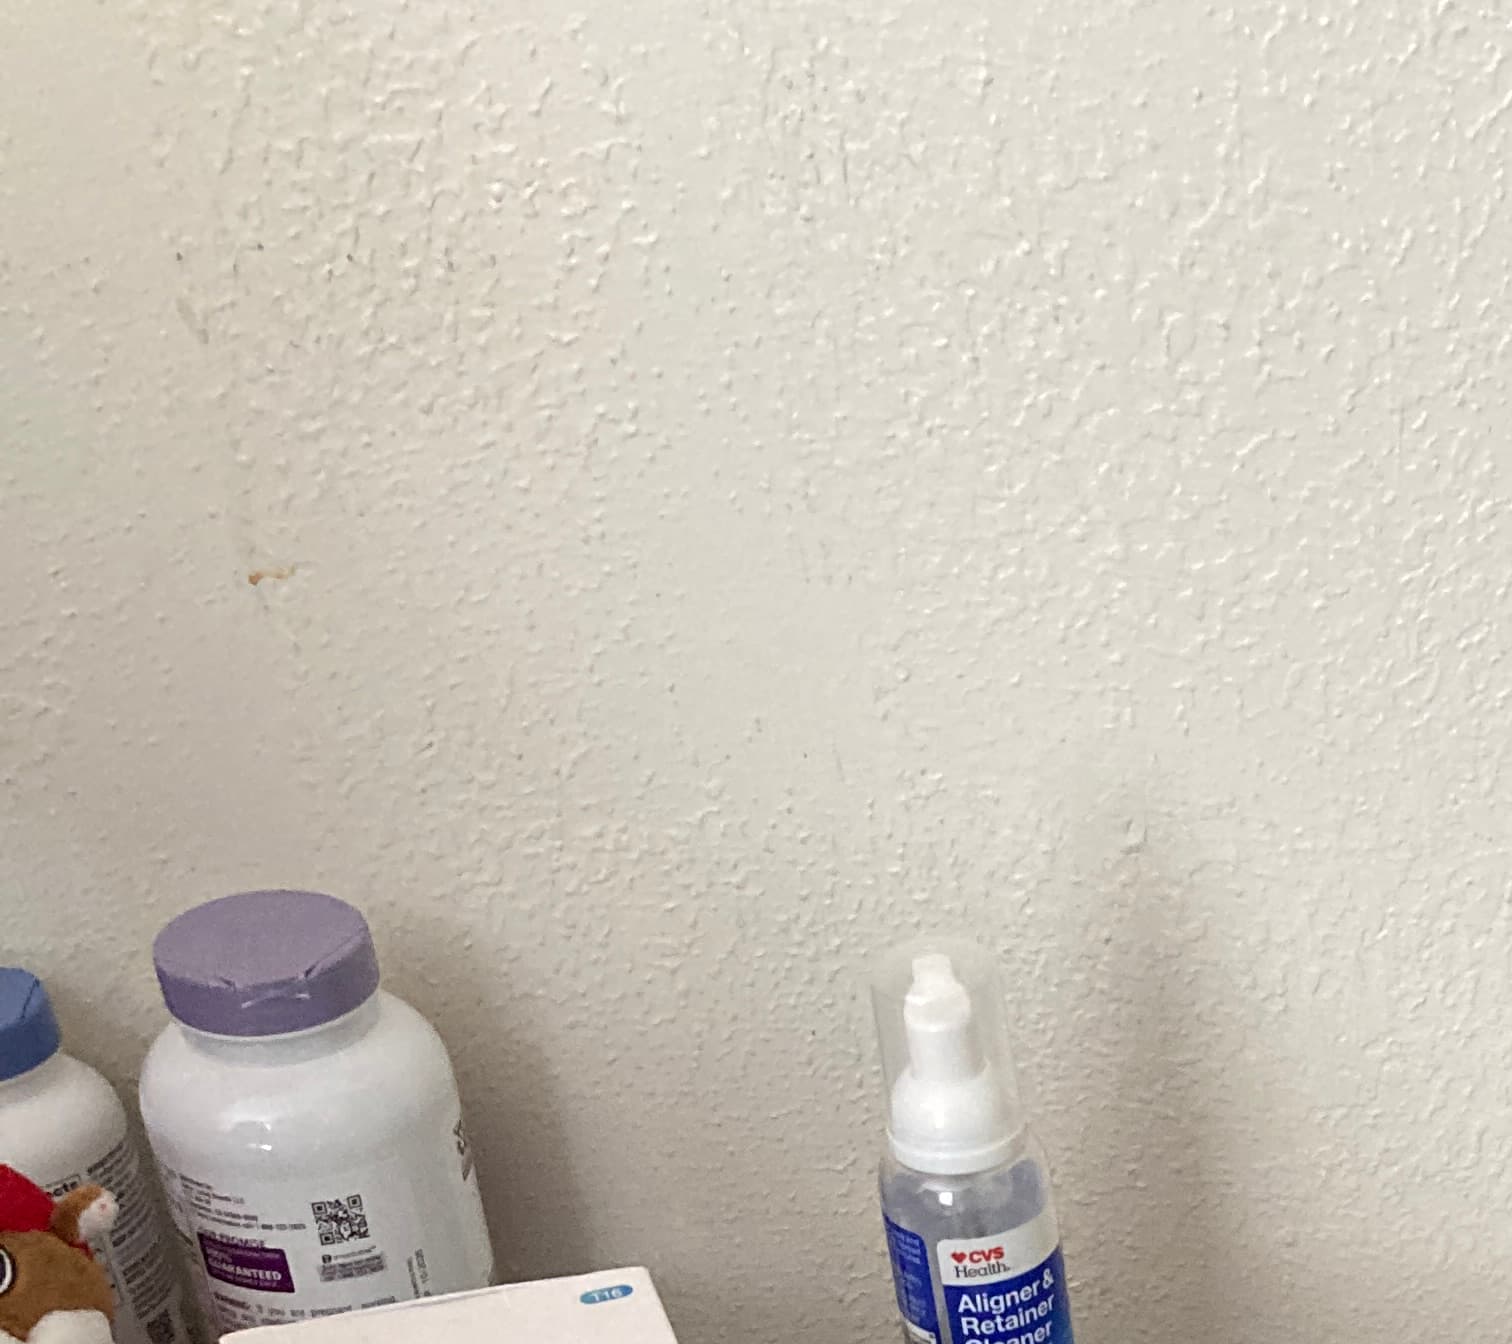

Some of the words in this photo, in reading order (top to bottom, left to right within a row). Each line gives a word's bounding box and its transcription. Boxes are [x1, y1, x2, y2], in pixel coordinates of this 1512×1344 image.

[968, 1246, 1004, 1264] CVS
[958, 1279, 1040, 1315] Aligner
[1042, 1268, 1055, 1289] &
[961, 1294, 1054, 1336] Retainer
